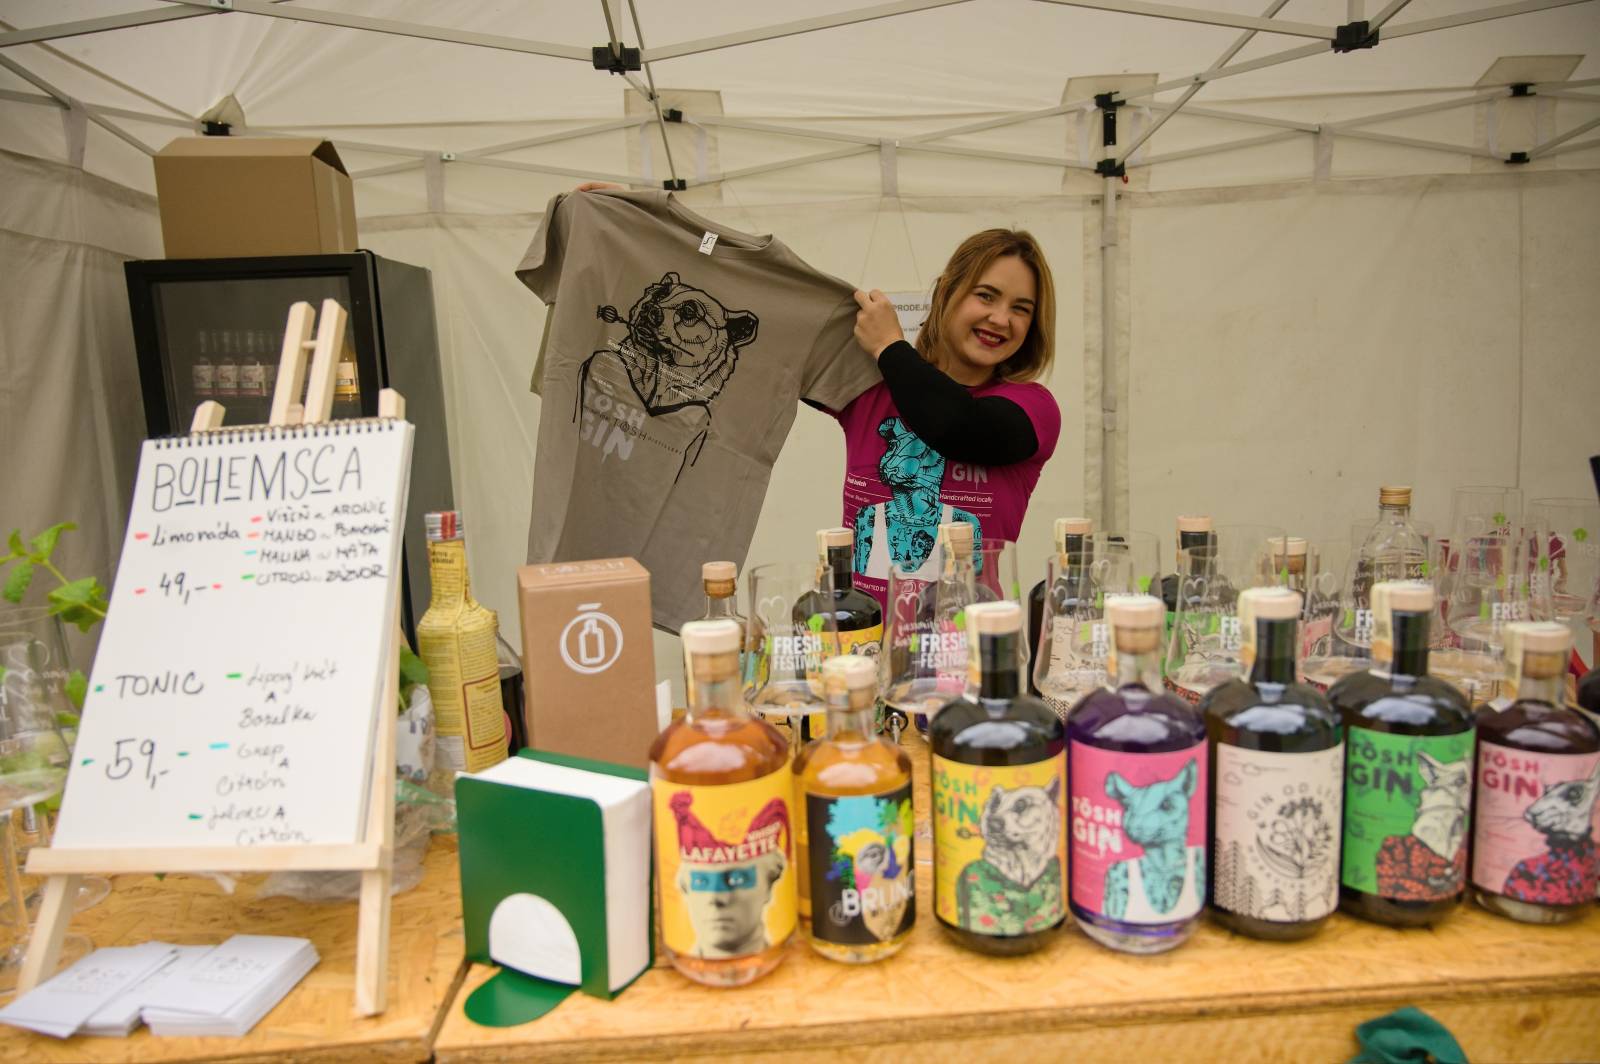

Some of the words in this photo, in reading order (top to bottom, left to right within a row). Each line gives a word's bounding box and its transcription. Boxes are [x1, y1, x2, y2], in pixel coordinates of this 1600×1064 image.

[152, 444, 362, 512] BOHEMSCA
[939, 493, 976, 502] Handcrafted
[976, 495, 993, 504] locally
[773, 635, 822, 655] FRESH
[920, 632, 968, 652] FRESH
[116, 671, 204, 698] TONIC
[1350, 762, 1414, 802] GIN
[1482, 767, 1540, 803] GIN
[933, 790, 980, 824] GIN
[680, 836, 779, 863] LAFAYETTE
[1073, 816, 1123, 858] GIN
